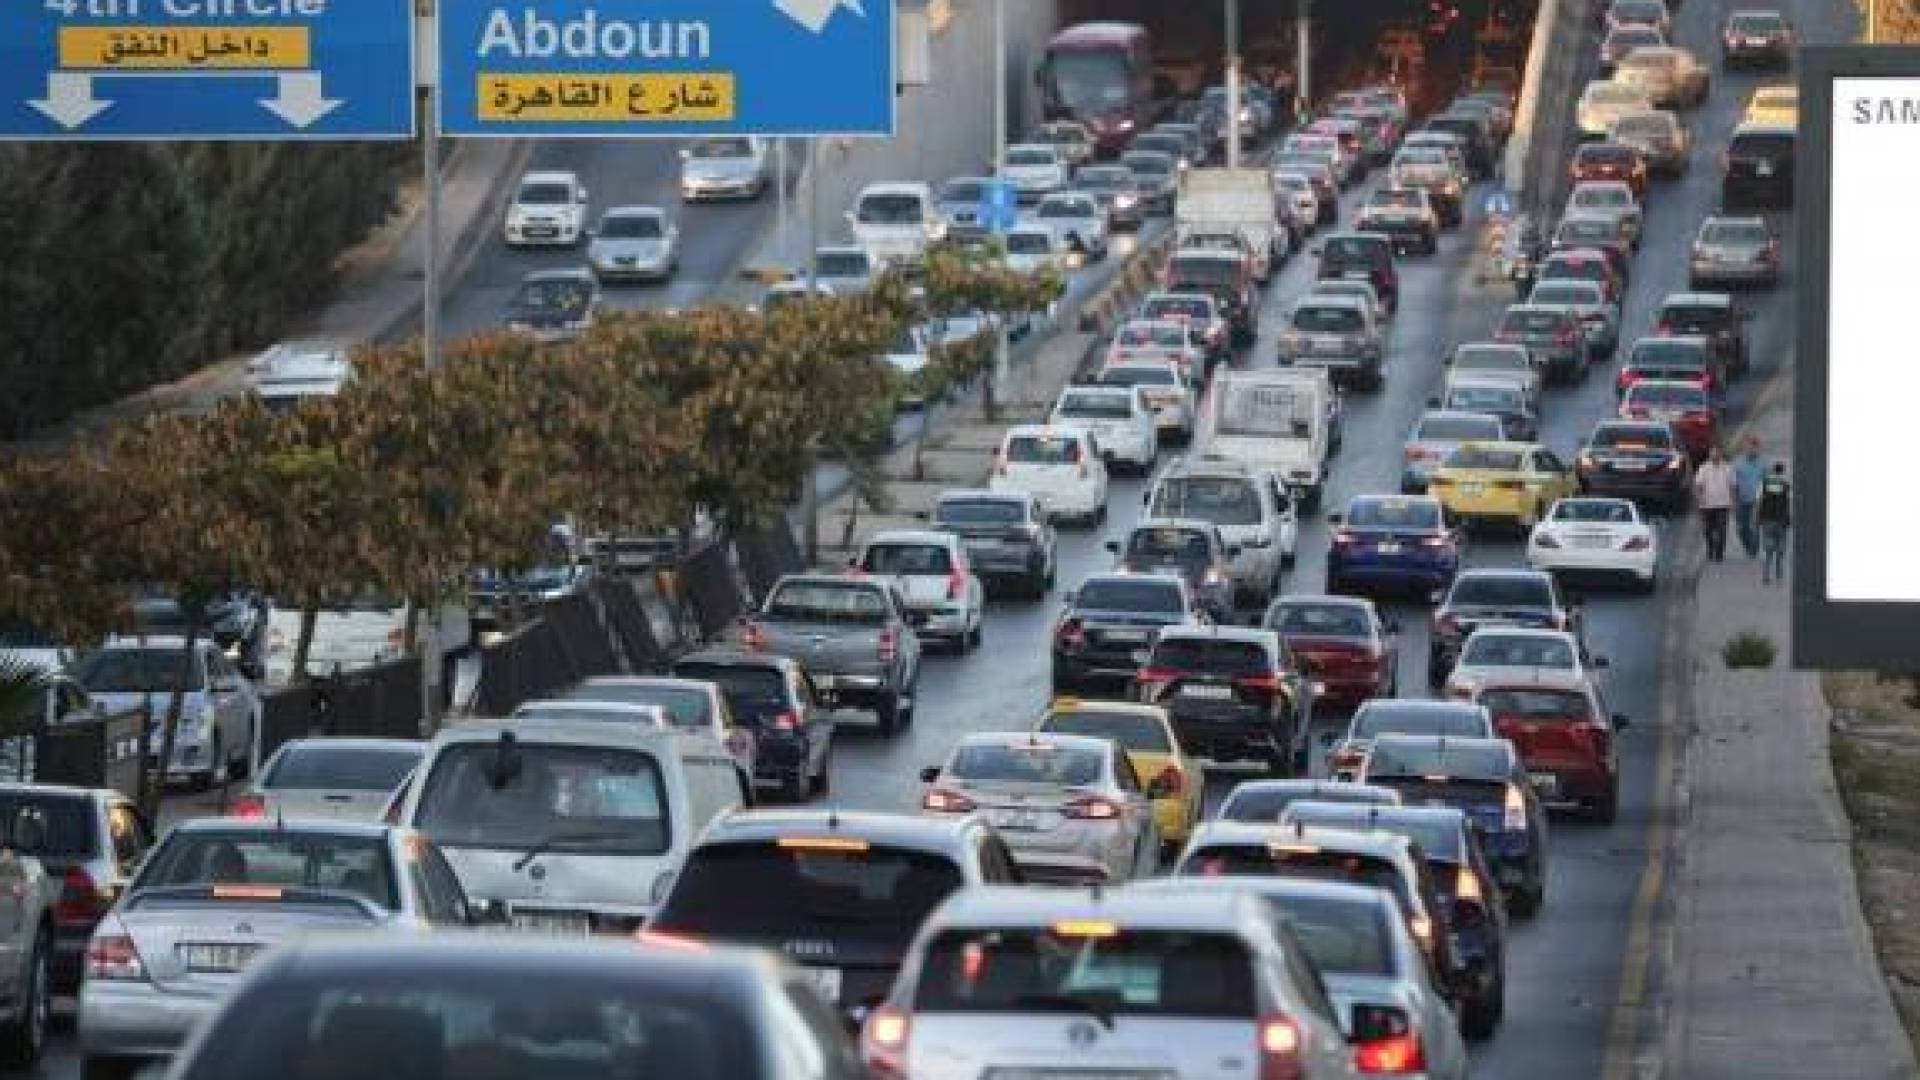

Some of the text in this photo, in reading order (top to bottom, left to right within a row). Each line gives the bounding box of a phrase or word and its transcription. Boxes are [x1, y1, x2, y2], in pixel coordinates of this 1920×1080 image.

[102, 32, 269, 63] داخل النفق
[477, 8, 711, 58] Abdoun
[494, 80, 720, 114] شارع القاهرة
